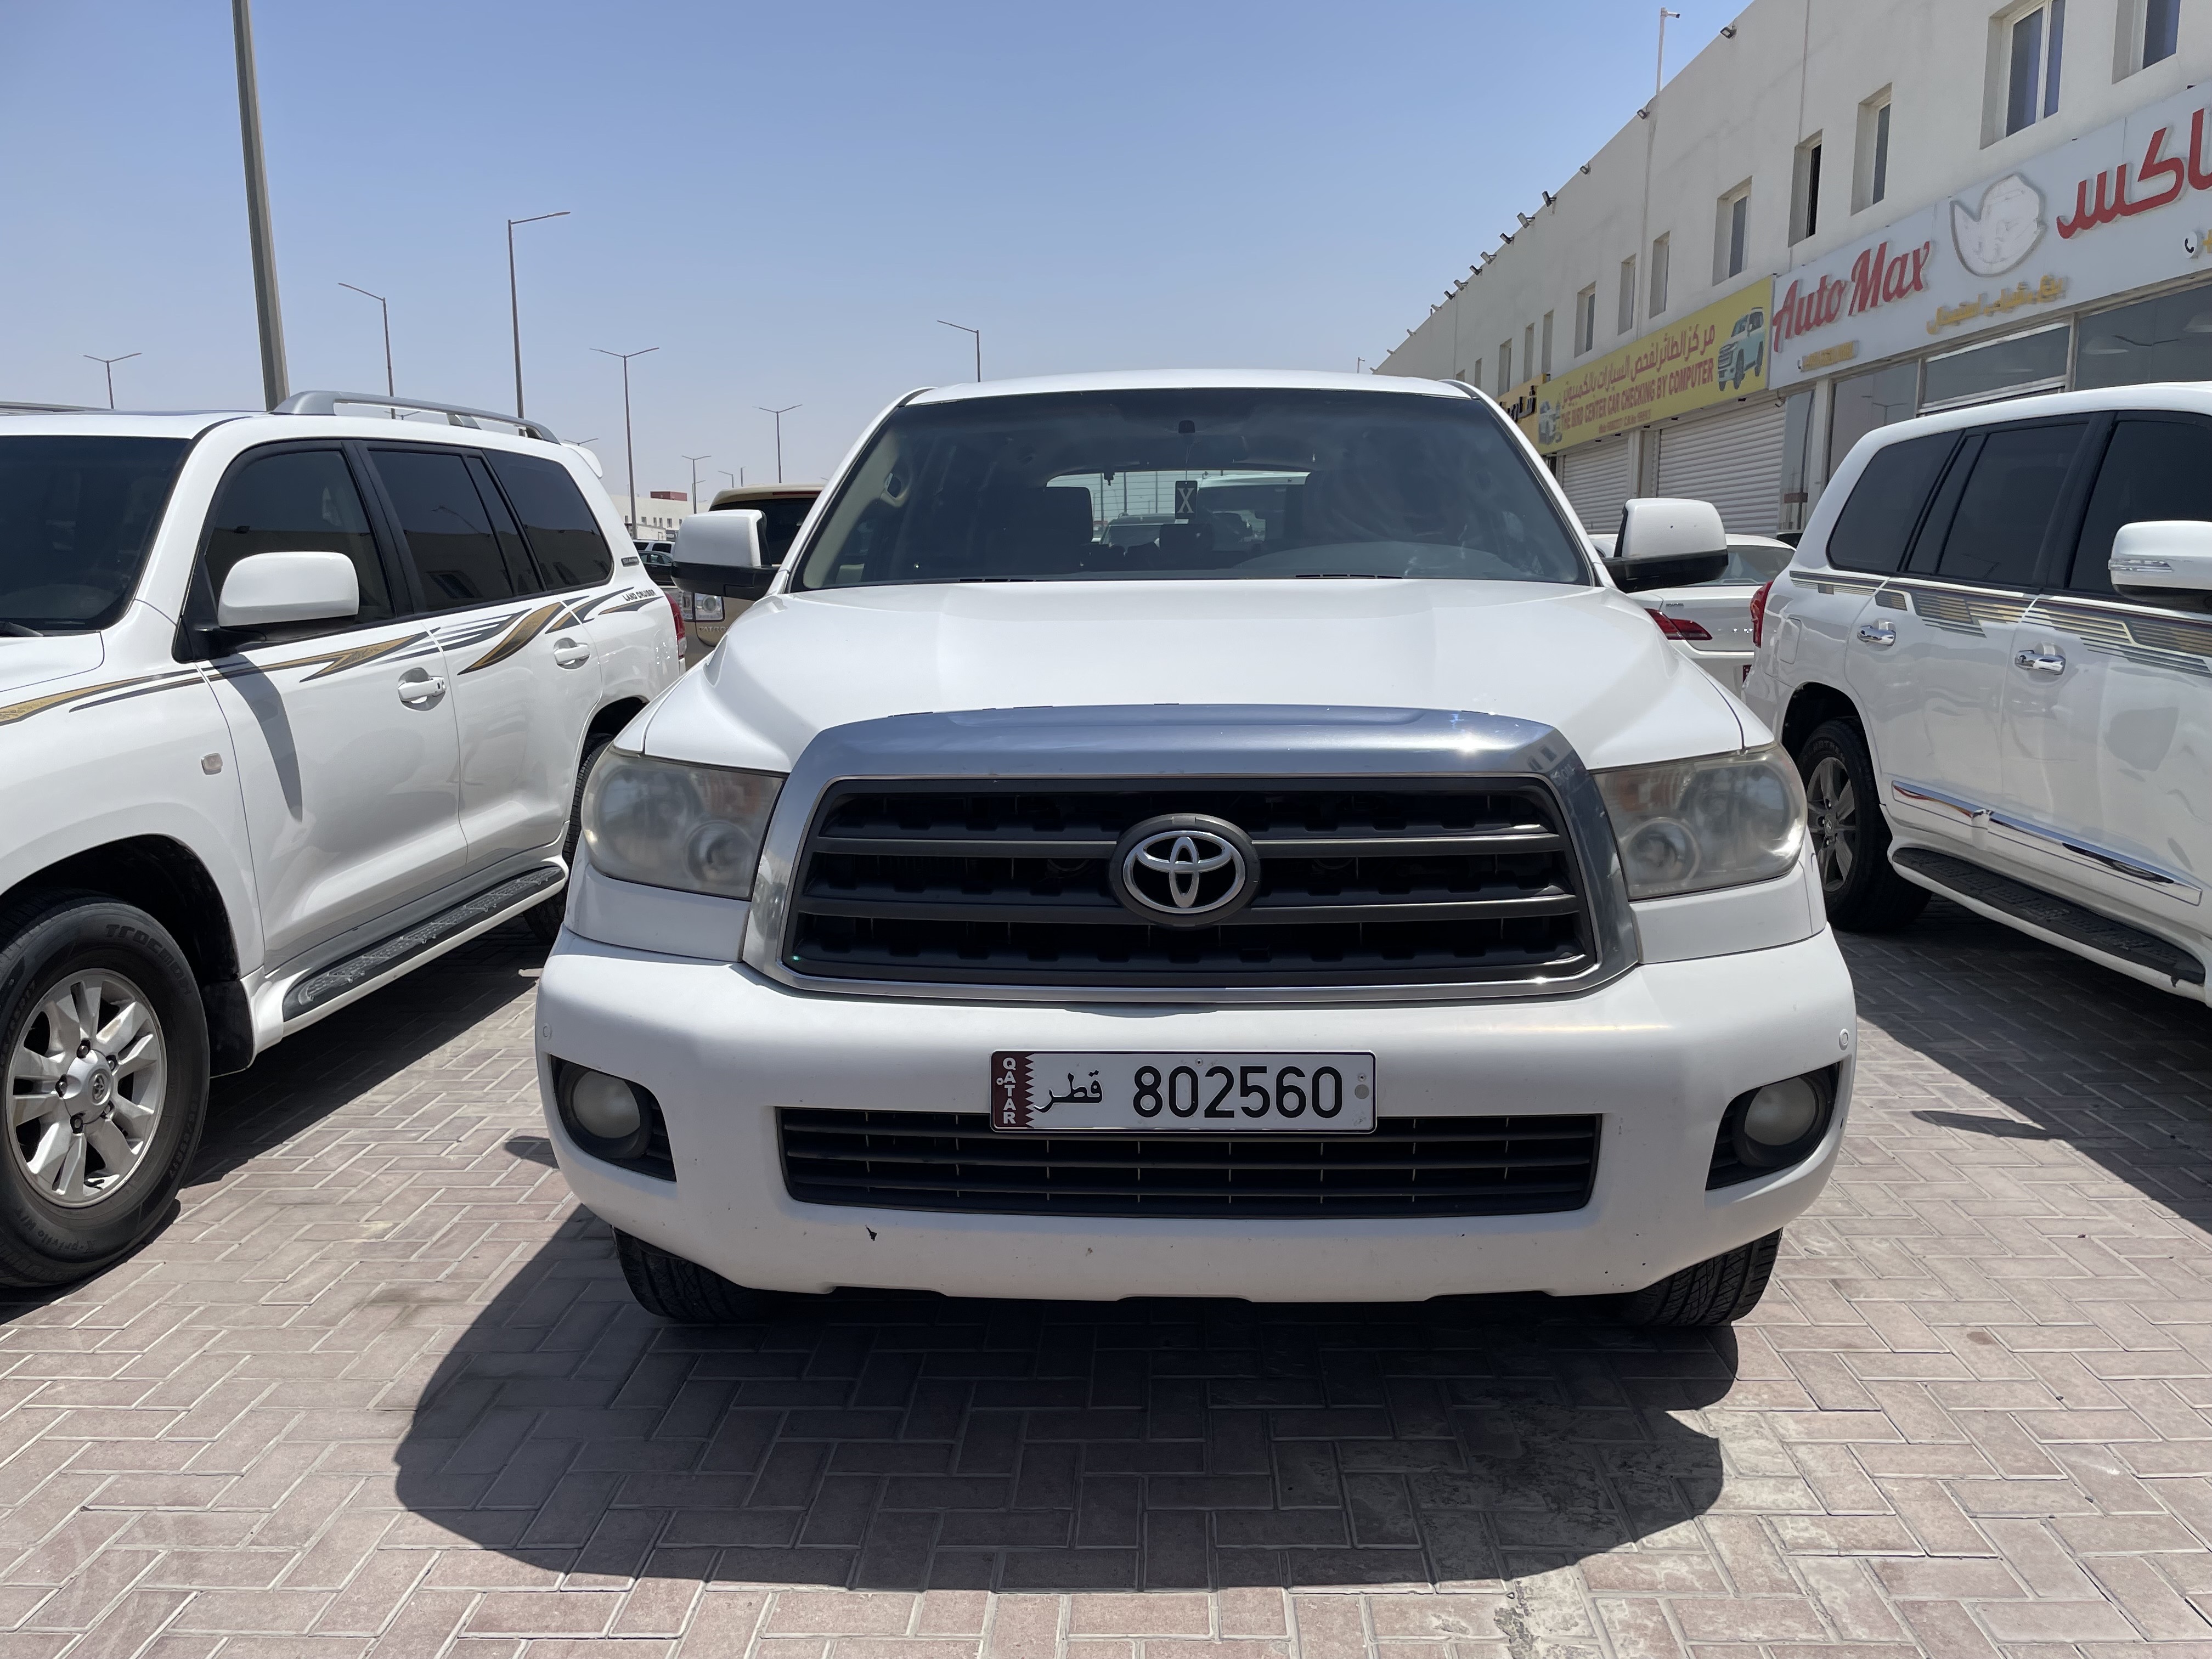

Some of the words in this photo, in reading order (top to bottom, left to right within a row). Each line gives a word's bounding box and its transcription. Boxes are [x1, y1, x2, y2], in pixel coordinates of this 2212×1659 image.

[2056, 108, 2212, 240] اكس
[1773, 275, 1845, 353] Auto
[1848, 241, 1931, 317] Max
[1630, 342, 1658, 382] لفحص
[1684, 324, 1715, 362] مركز
[1607, 393, 1620, 415] CAR
[1621, 379, 1655, 410] CHECKING
[1656, 375, 1668, 399] BY
[1668, 358, 1714, 396] COMPUTER
[1177, 488, 1195, 514] X
[622, 592, 637, 601] LAND
[1003, 1057, 1017, 1125] QATAR
[1033, 1069, 1103, 1113] قطر
[1133, 1065, 1343, 1119] 802560
